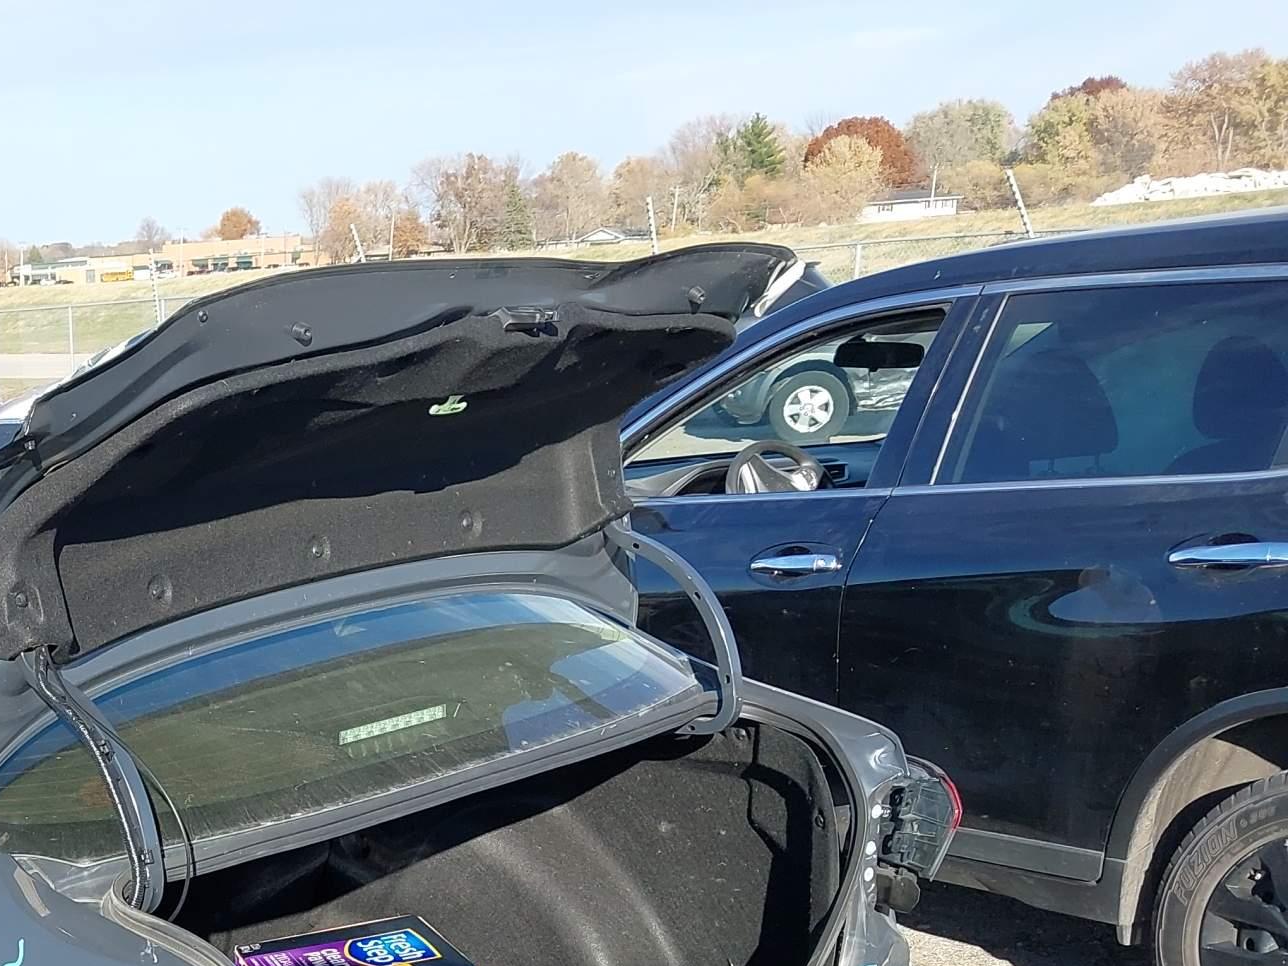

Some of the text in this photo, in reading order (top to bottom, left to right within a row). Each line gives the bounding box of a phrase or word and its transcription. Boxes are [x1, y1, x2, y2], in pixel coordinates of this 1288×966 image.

[1173, 814, 1238, 907] FUZION
[356, 939, 395, 963] Step
[380, 933, 426, 961] Fresh
